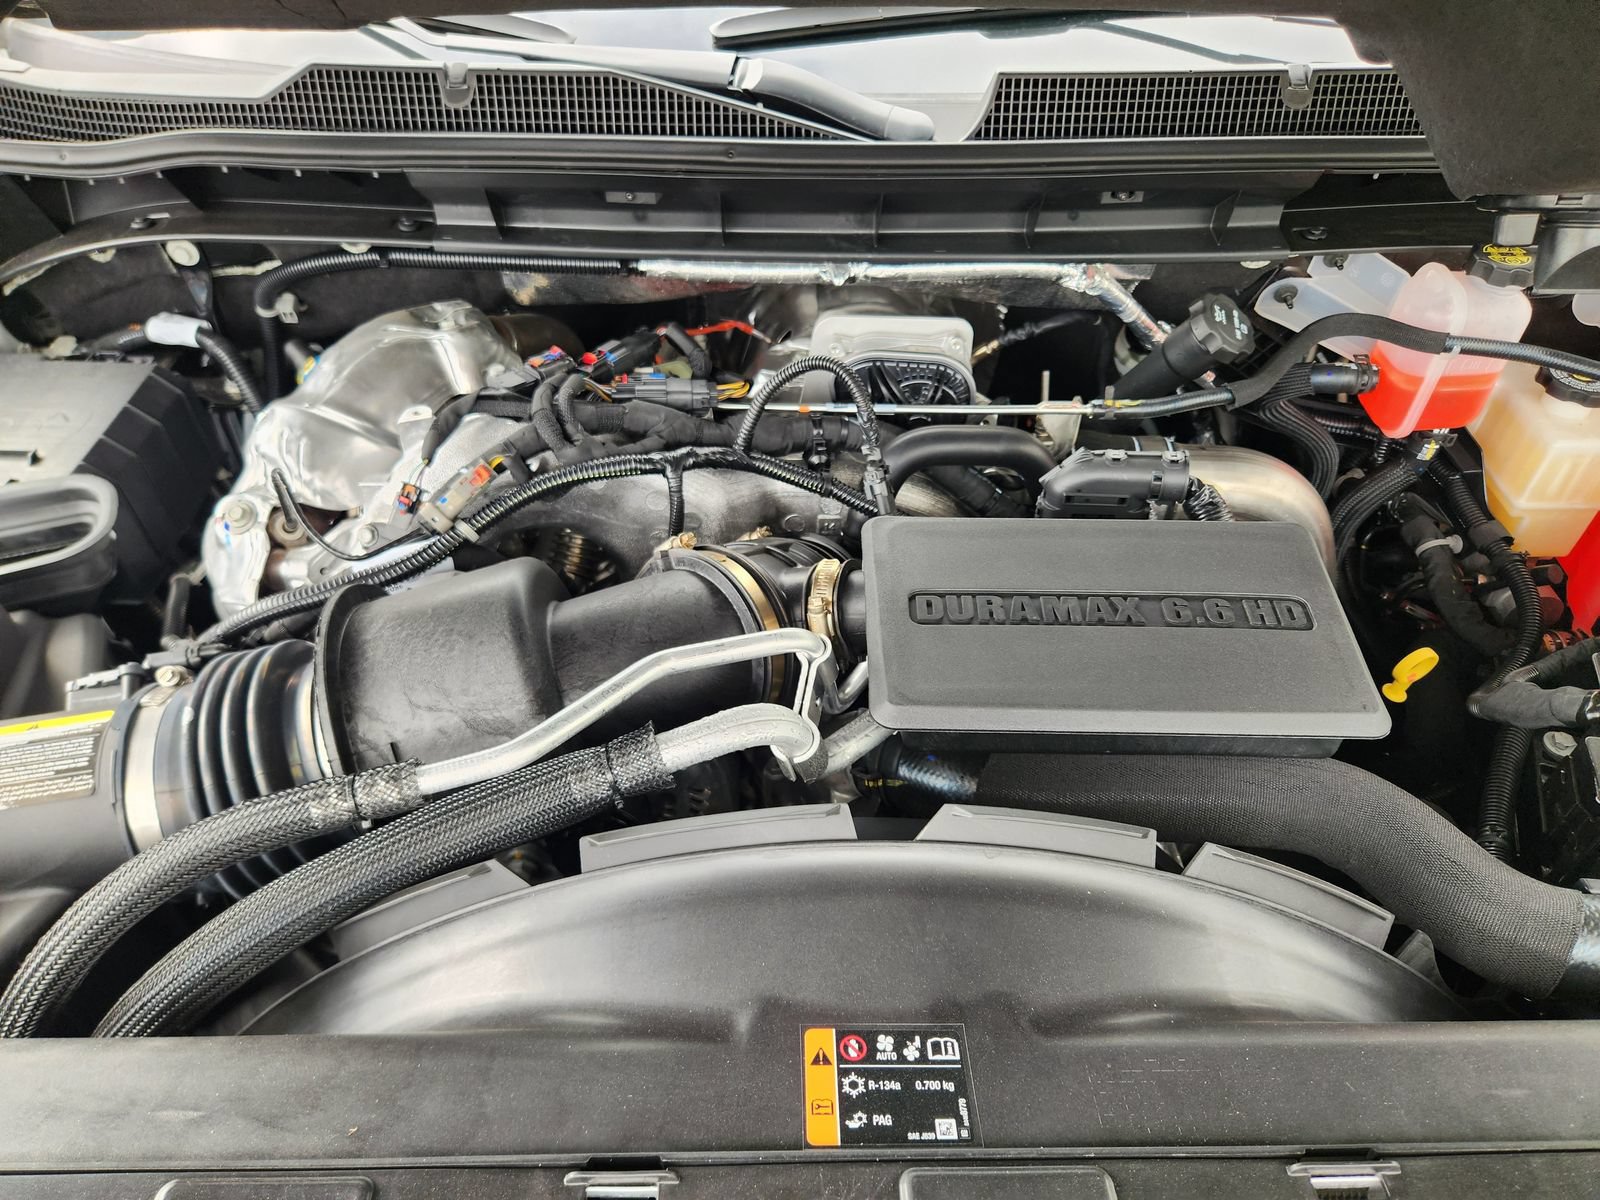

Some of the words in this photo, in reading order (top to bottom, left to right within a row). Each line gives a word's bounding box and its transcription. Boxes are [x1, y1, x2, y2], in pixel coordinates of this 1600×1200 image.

[915, 595, 1145, 625] DURAMAX
[1161, 597, 1236, 626] 6.6
[1242, 599, 1308, 628] HD
[876, 1052, 898, 1060] AUTO
[868, 1080, 902, 1091] R-134a
[915, 1080, 941, 1091] 0.700
[942, 1080, 955, 1092] kg
[872, 1114, 893, 1126] PAG
